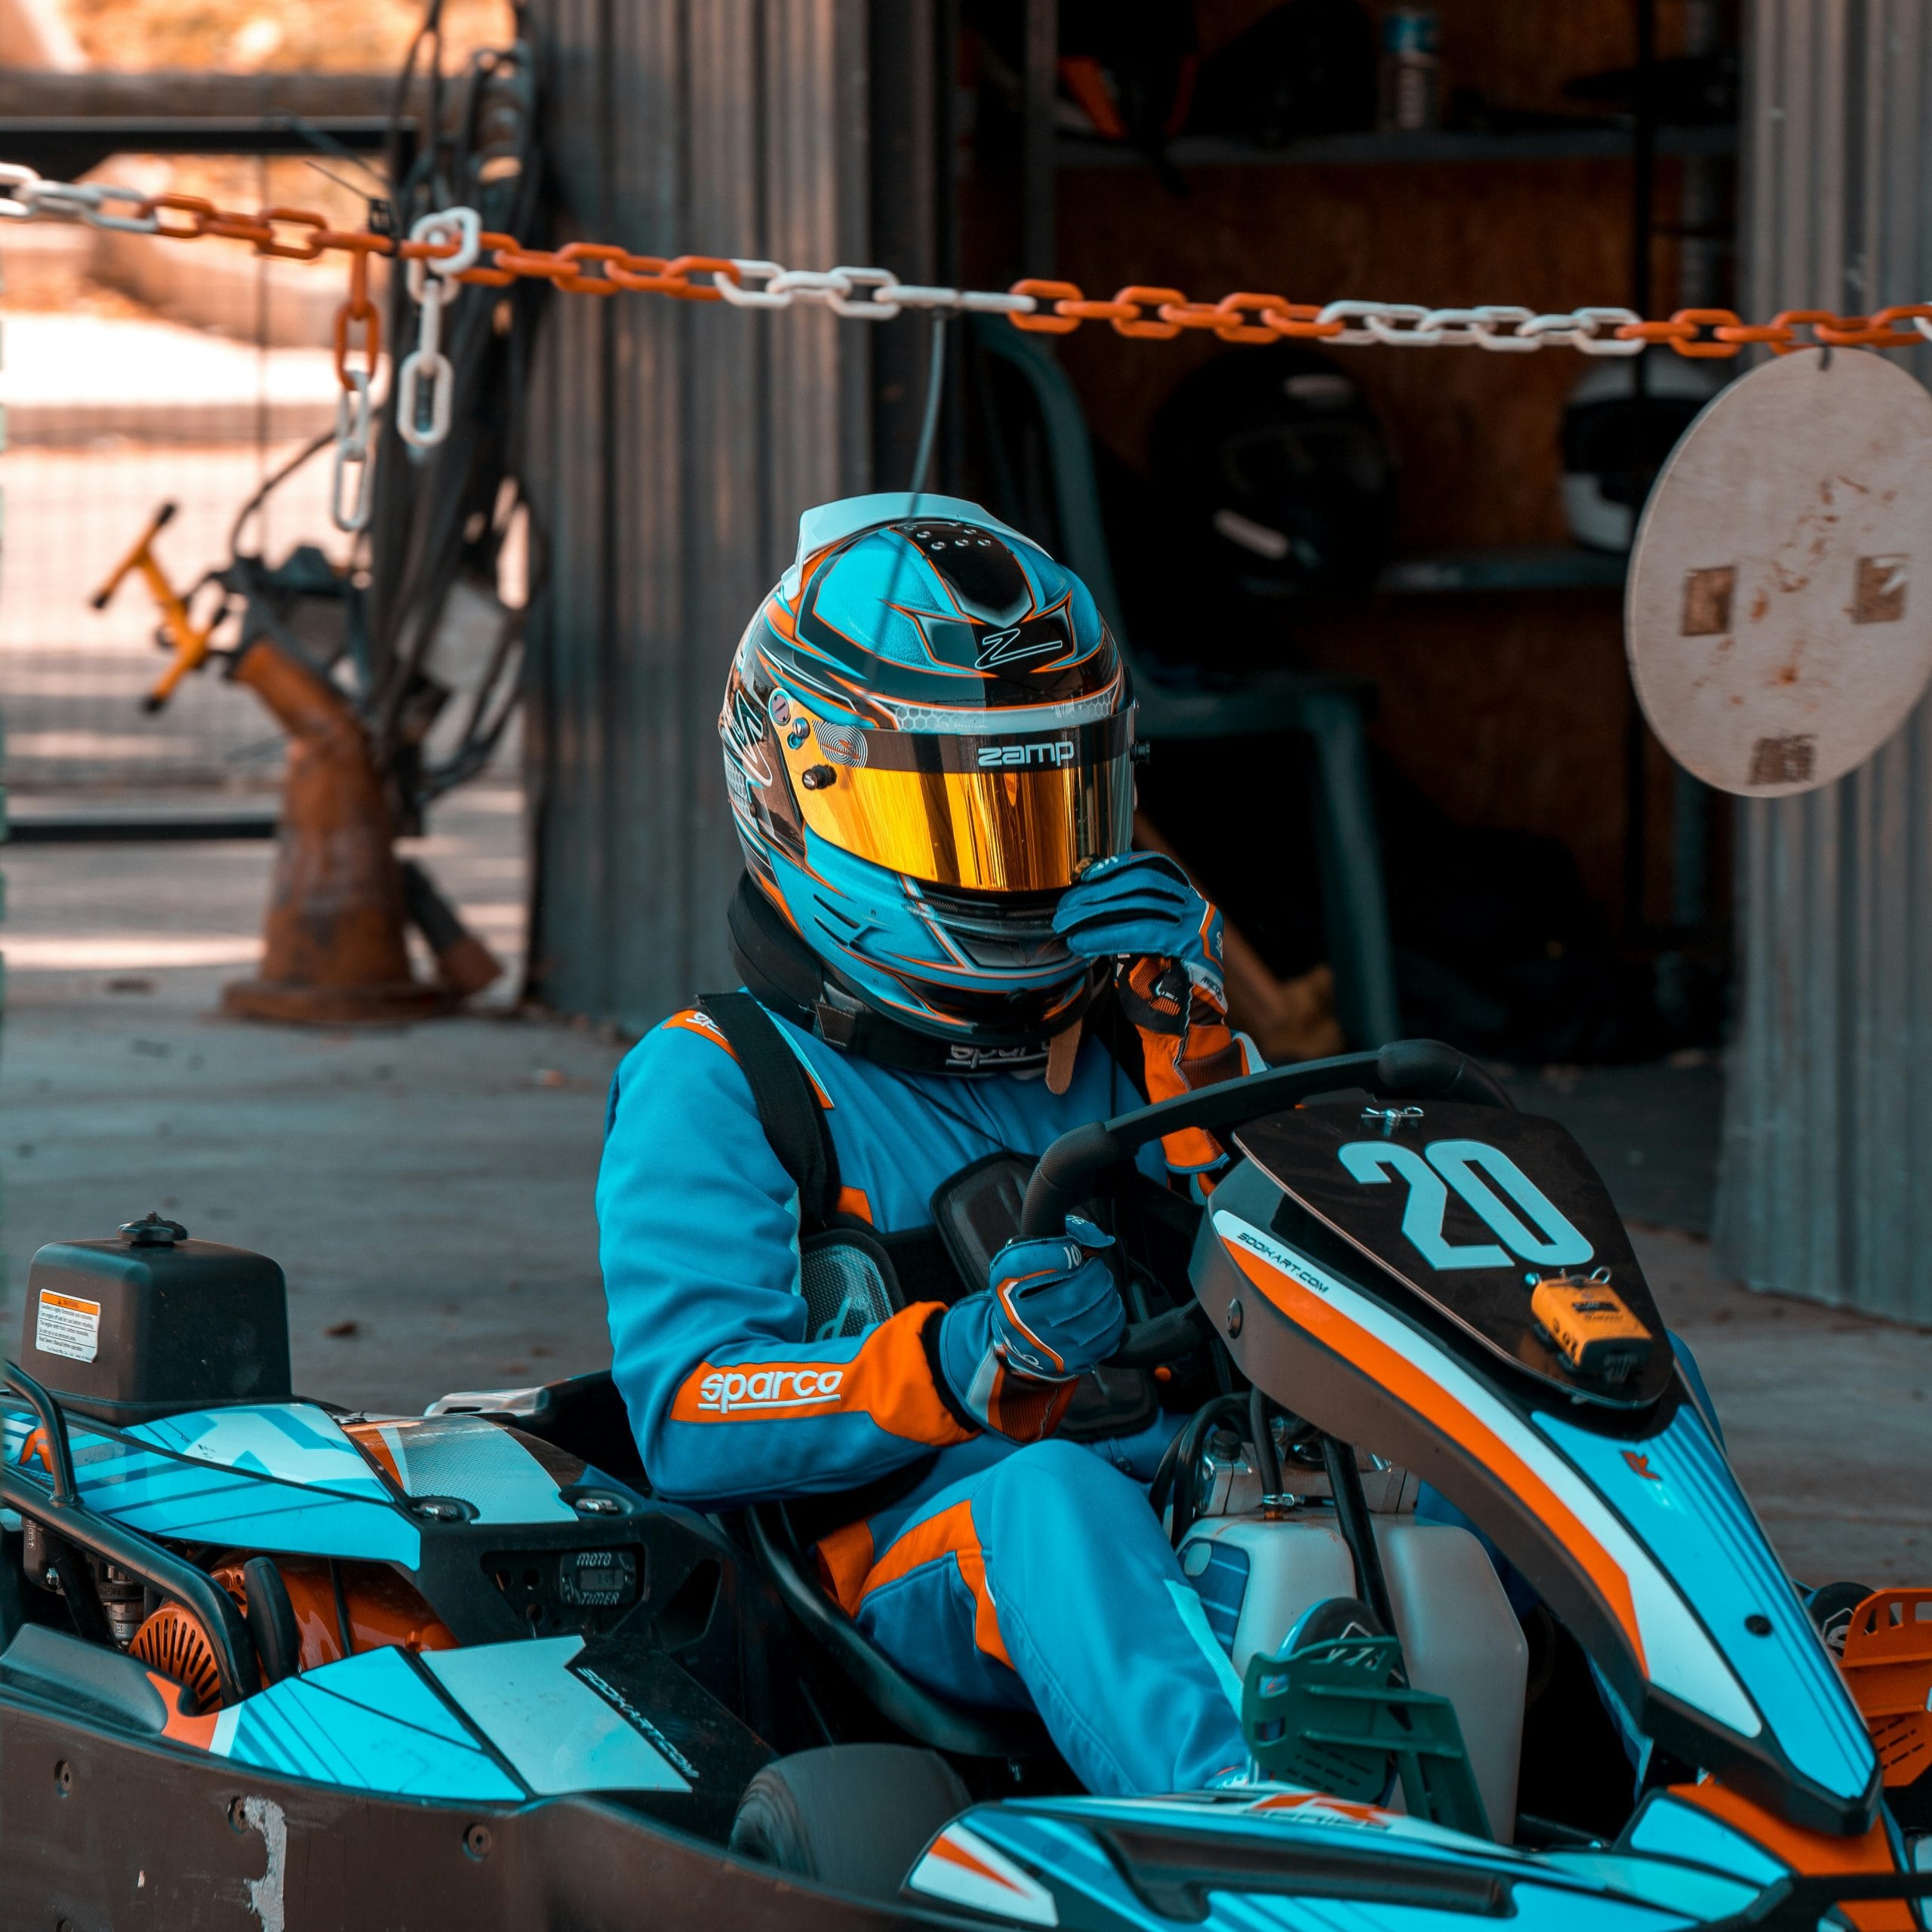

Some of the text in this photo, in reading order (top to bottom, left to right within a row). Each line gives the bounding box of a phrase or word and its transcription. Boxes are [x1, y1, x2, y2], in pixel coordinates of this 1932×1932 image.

[978, 741, 1074, 766] zamp
[1338, 1139, 1595, 1270] 20
[1237, 1232, 1329, 1294] SODIKART.COM
[697, 1371, 844, 1414] sparco
[577, 1552, 611, 1567] MOTO
[581, 1591, 620, 1605] TIMER
